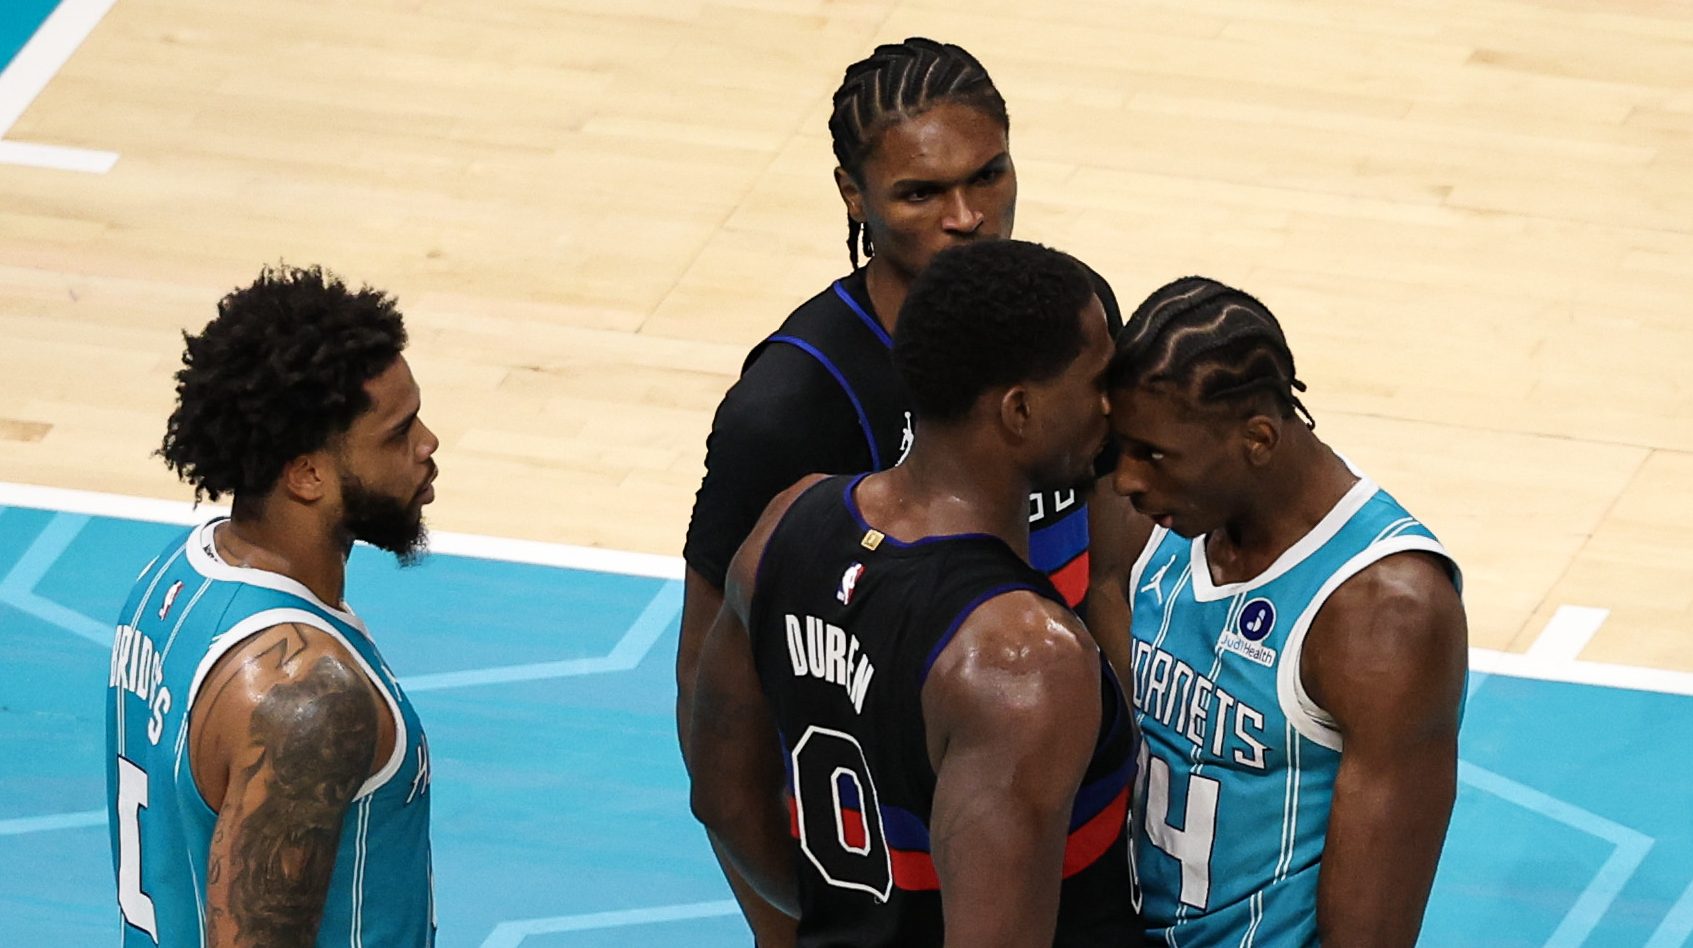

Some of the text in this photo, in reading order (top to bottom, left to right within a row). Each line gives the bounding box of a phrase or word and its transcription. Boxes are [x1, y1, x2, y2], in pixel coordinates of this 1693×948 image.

[785, 614, 875, 715] DUREN
[1130, 637, 1267, 769] ORNETS
[117, 755, 158, 944] 1
[791, 725, 893, 903] 0
[1134, 741, 1220, 910] 4
